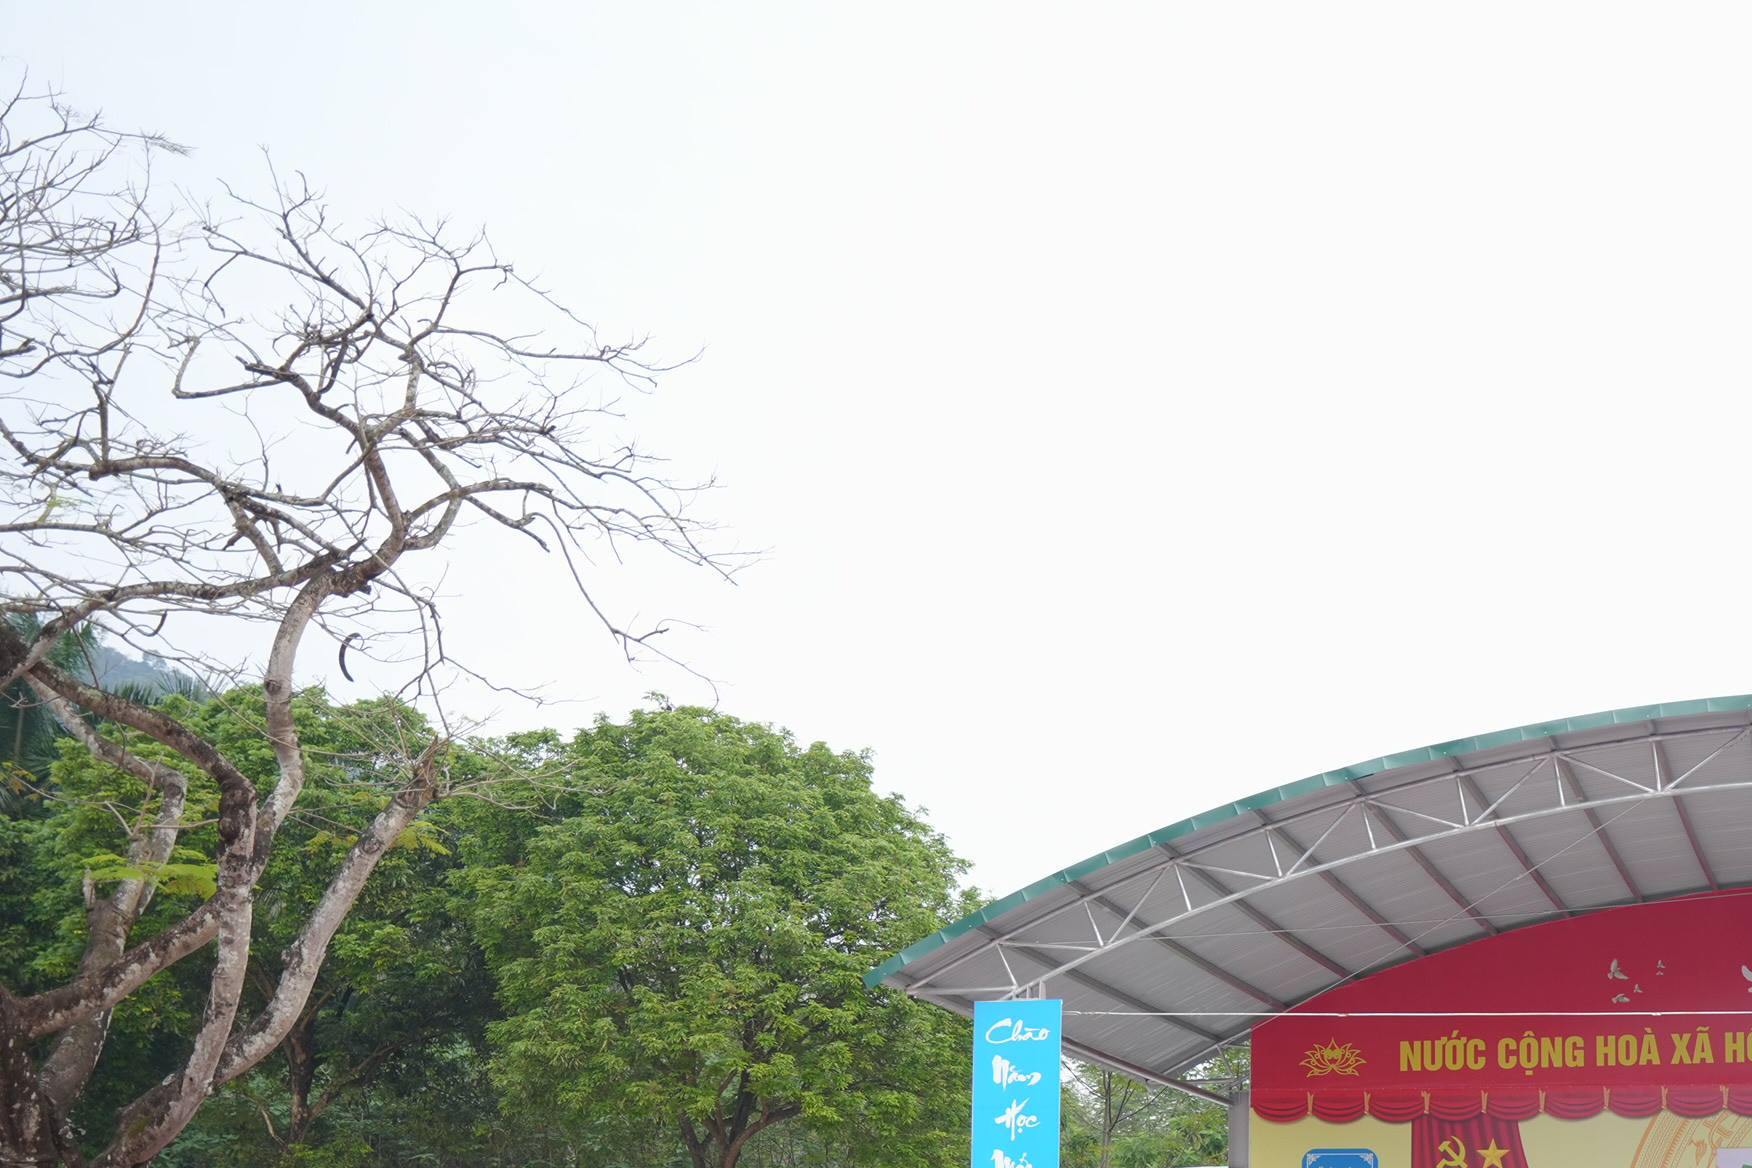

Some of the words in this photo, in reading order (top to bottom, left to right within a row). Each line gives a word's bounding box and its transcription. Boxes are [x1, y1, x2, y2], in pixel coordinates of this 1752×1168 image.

[985, 1017, 1050, 1044] Chào
[1399, 1030, 1487, 1072] NƯỚC
[1498, 1030, 1585, 1075] CỘNG
[1596, 1027, 1660, 1066] HOÀ
[1671, 1026, 1714, 1065] XÃ
[992, 1054, 1042, 1091] Năm
[994, 1097, 1041, 1141] Học
